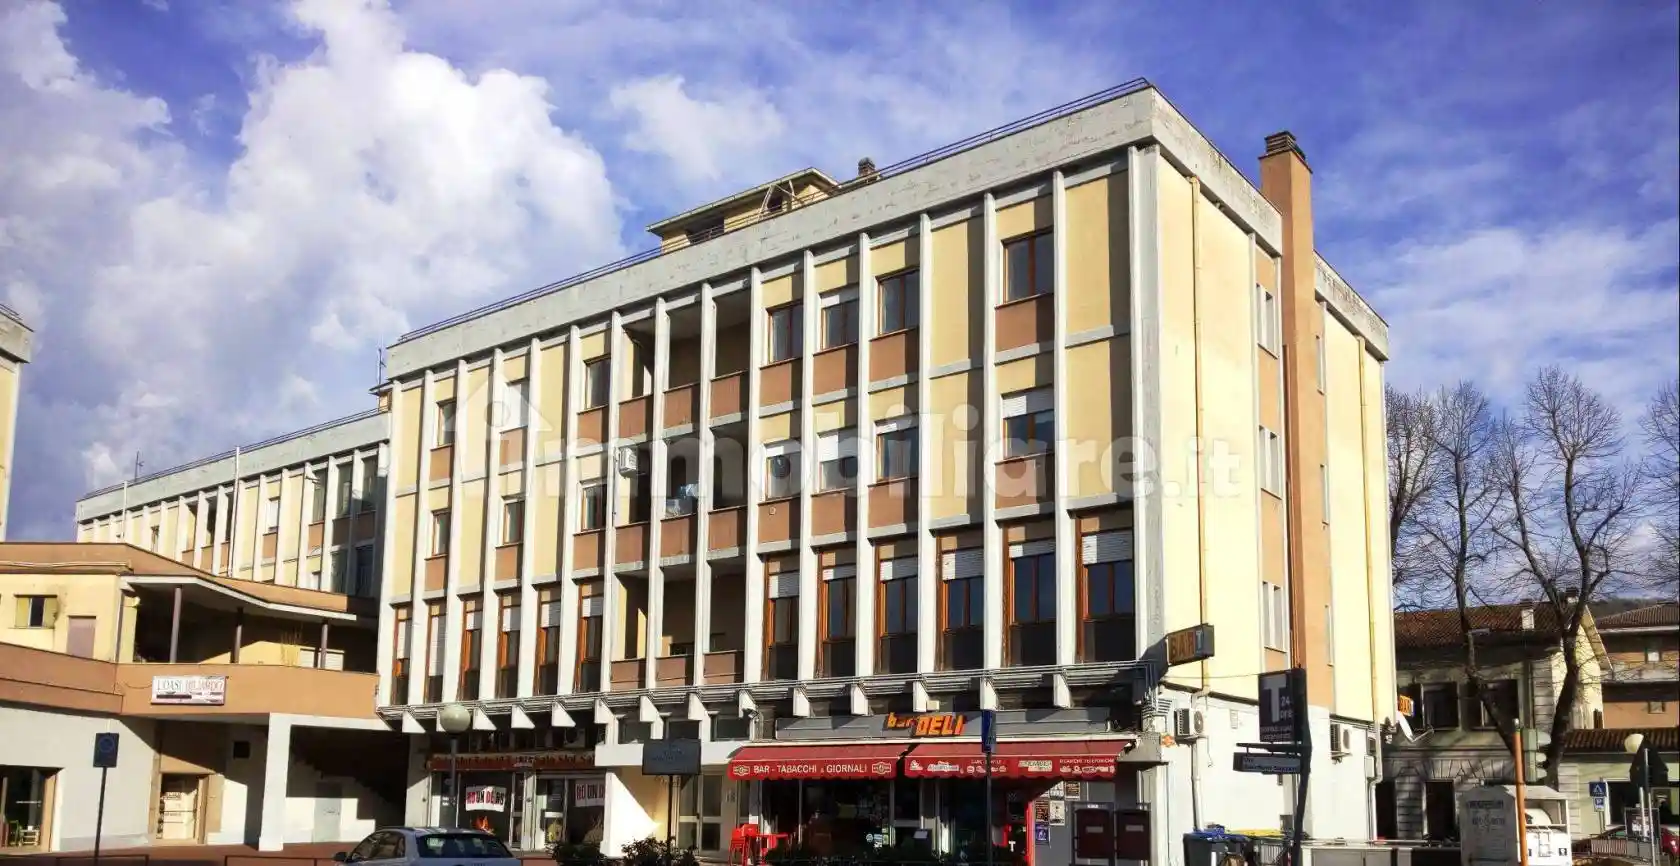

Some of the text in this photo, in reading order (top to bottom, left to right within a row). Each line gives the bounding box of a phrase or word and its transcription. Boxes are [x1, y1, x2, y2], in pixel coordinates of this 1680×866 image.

[1170, 632, 1194, 660] BAR
[1261, 674, 1287, 723] T
[887, 712, 965, 736] bar DELI
[754, 765, 769, 774] BAR
[777, 764, 817, 774] TABACCHI
[826, 764, 868, 774] GIORNALI
